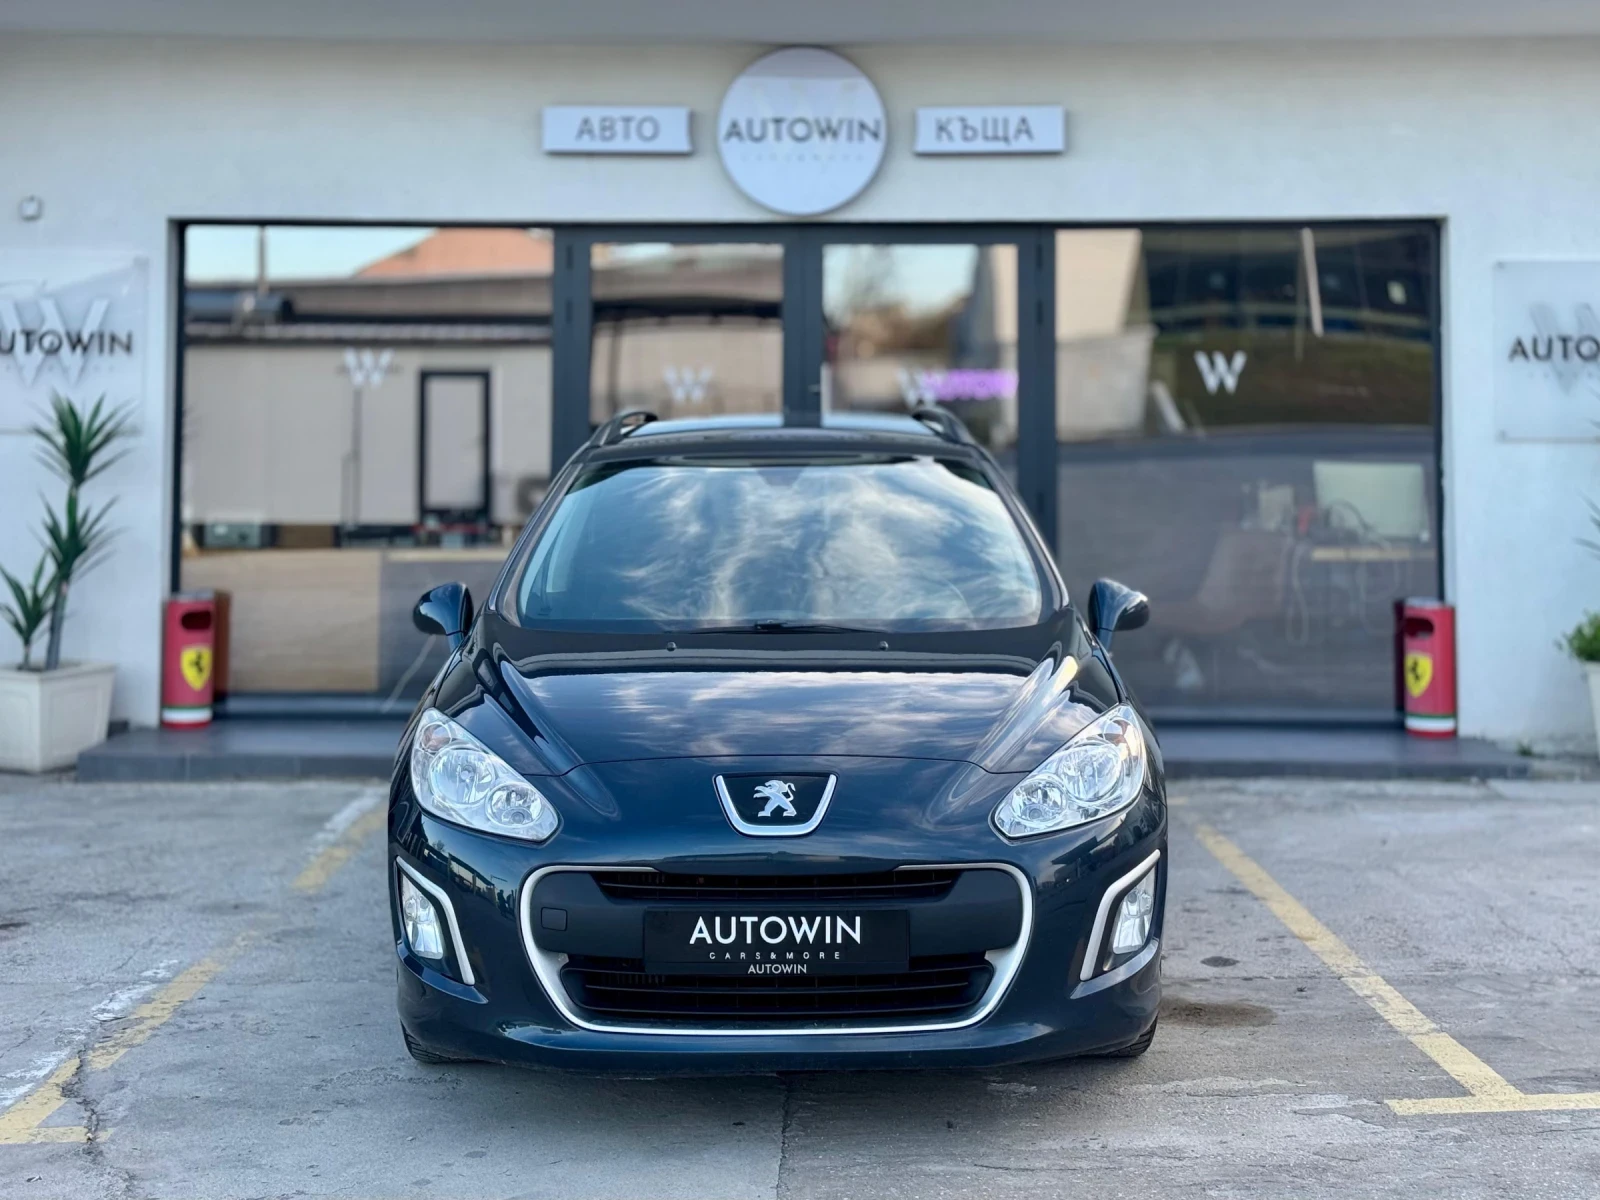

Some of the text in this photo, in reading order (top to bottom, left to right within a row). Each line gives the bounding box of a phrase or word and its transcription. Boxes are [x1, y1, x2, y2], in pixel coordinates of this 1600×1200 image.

[575, 115, 661, 142] АВТО
[723, 116, 881, 143] AUTOWIN
[934, 115, 1035, 147] КЪЩА
[0, 329, 133, 356] UTOWIN
[1507, 334, 1600, 362] AUTO
[1194, 350, 1247, 395] W
[689, 915, 861, 945] AUTOWIN
[747, 963, 807, 974] AUTOWIN
